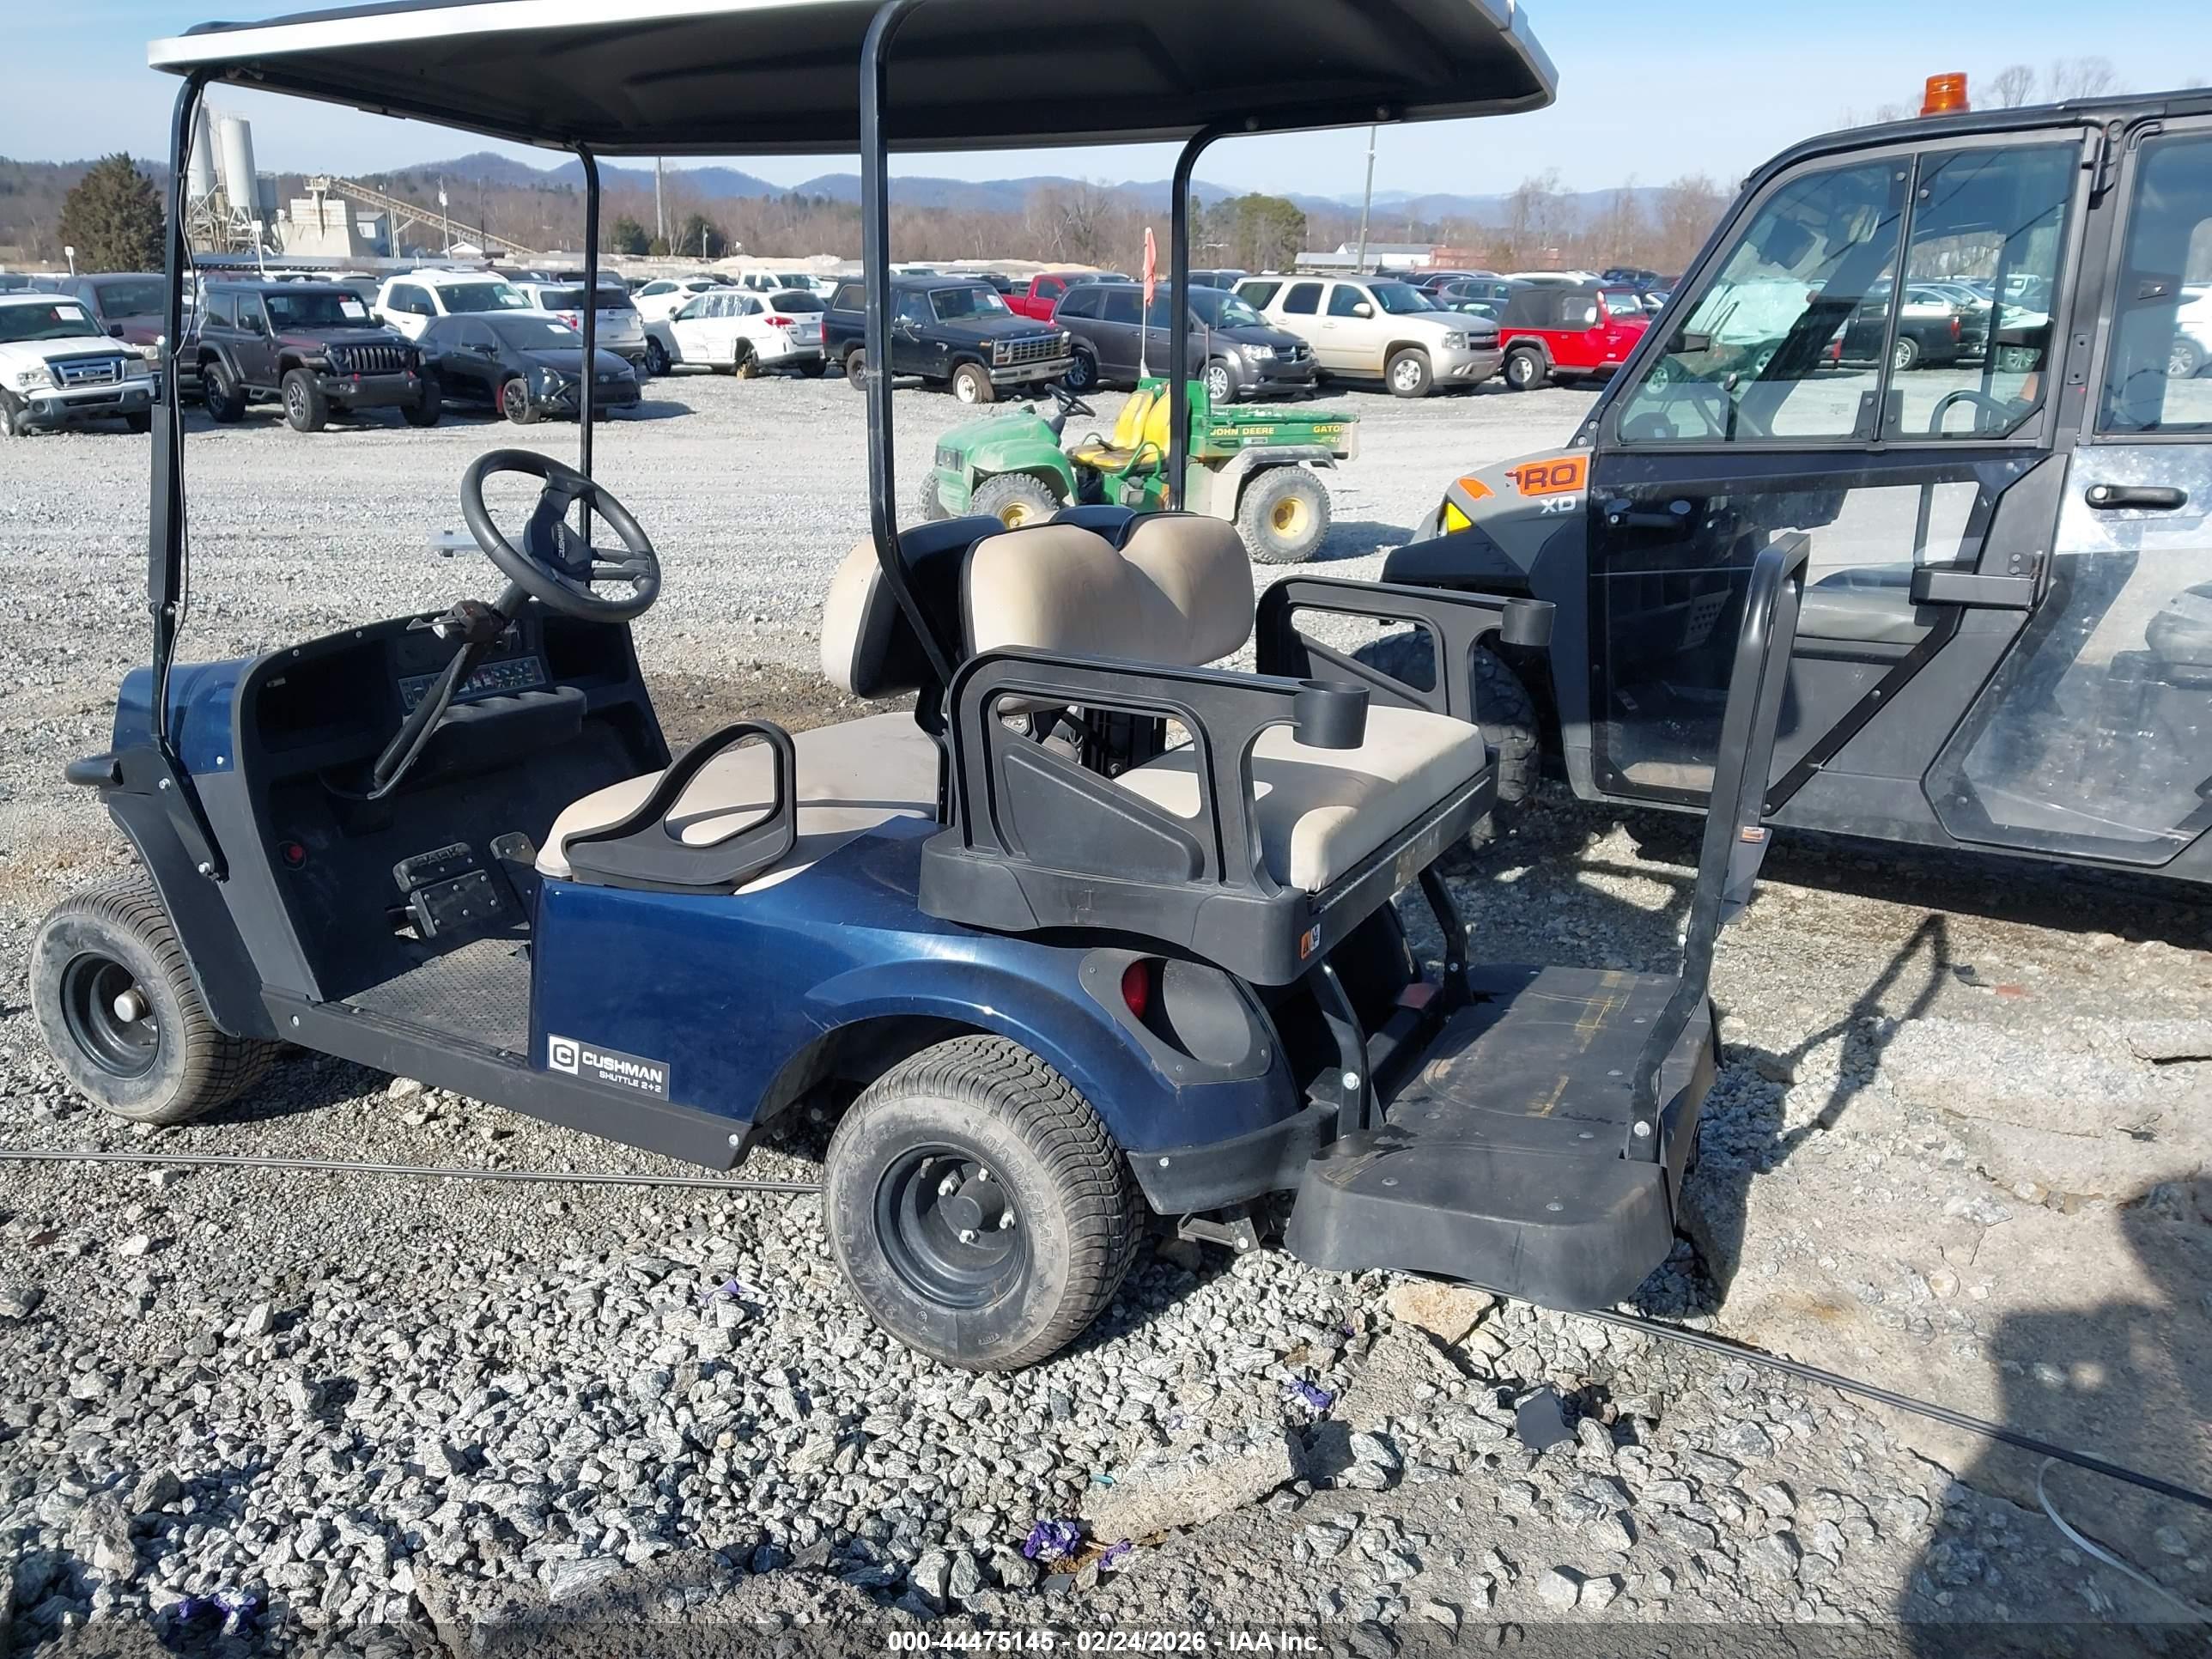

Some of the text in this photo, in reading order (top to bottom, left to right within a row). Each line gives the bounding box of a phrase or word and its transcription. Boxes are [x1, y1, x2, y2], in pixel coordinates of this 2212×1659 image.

[1210, 427, 1275, 436] JOHN DEERE
[1540, 495, 1577, 515] XD
[581, 1051, 664, 1084] CUSHMAN
[599, 1070, 663, 1094] SHUTTLE 2+2
